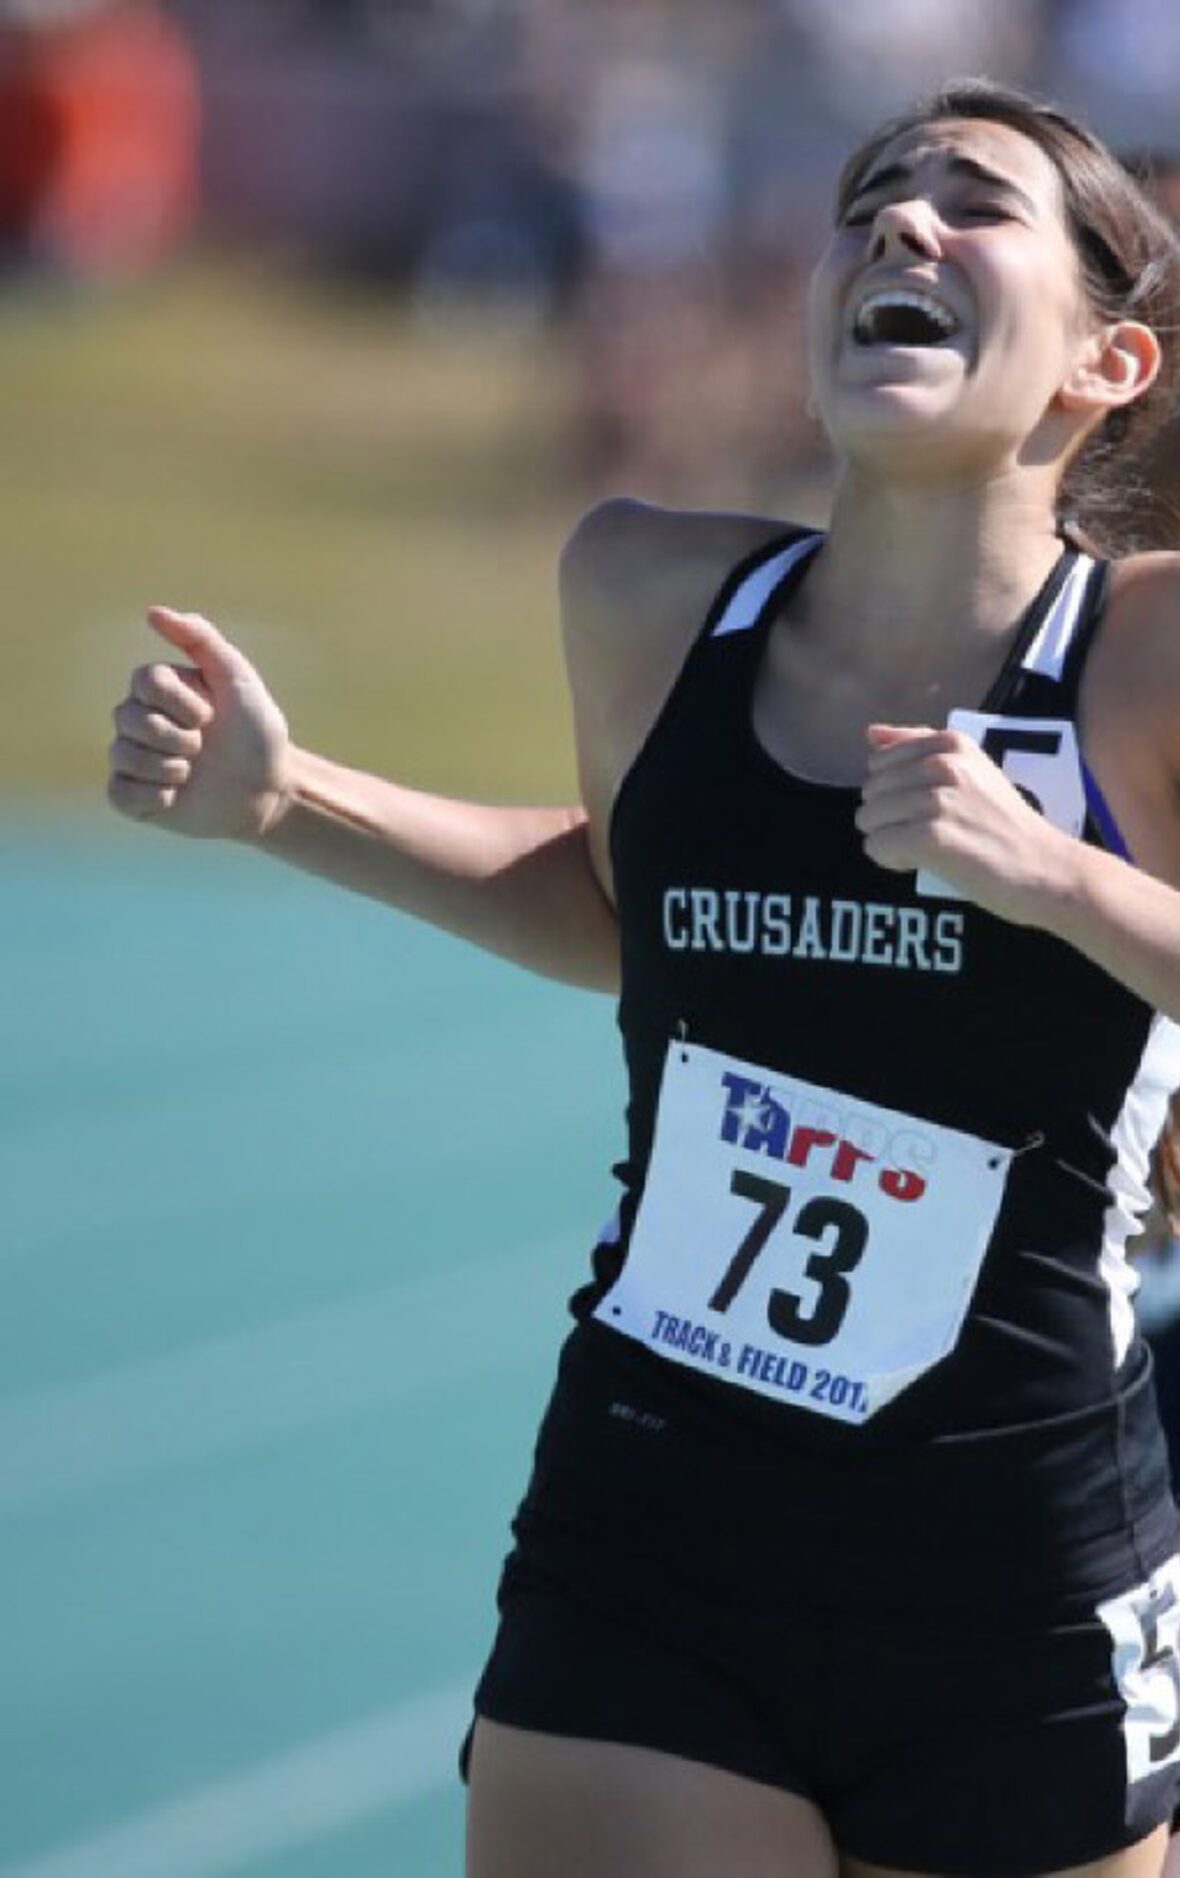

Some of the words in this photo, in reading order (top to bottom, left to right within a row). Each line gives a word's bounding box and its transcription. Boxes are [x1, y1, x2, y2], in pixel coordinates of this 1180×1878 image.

[662, 887, 966, 972] CRUSADERS
[707, 1169, 870, 1347] 73
[652, 1310, 721, 1362] TRACK
[737, 1344, 808, 1391] FIELD
